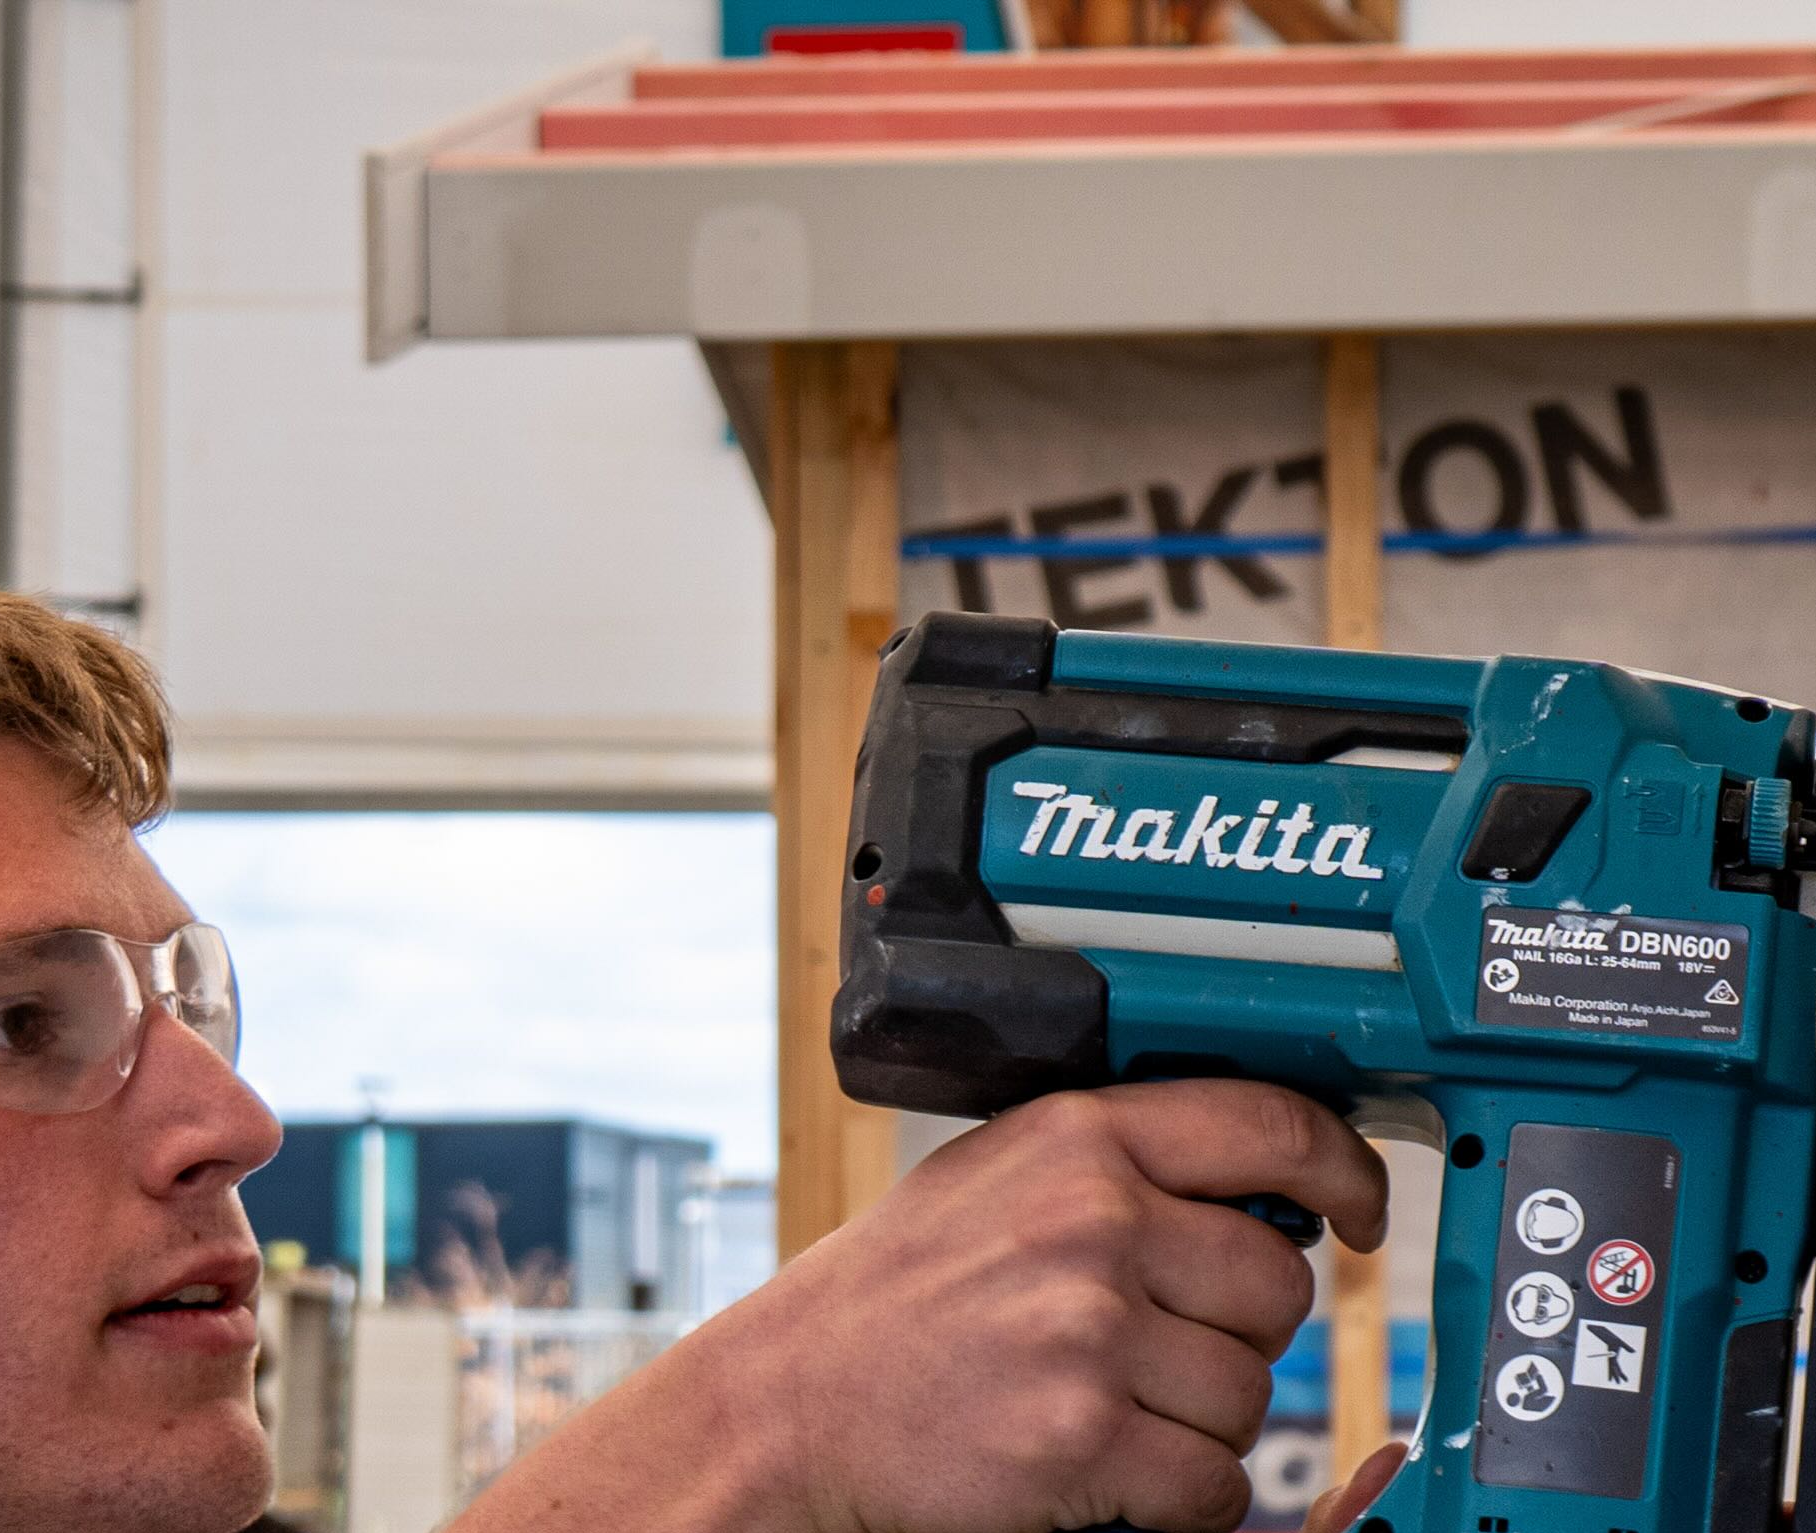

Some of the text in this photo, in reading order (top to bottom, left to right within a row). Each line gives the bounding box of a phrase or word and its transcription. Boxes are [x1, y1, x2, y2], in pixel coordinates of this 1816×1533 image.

[903, 385, 1673, 630] TEKON
[1620, 930, 1731, 961] DBN600
[1513, 949, 1545, 963] NAIL
[1549, 952, 1582, 966] 16Ga
[1601, 956, 1662, 971] 25-64mm
[1508, 991, 1551, 1007] Makita
[1554, 994, 1629, 1014] Corporation
[1568, 1011, 1649, 1029] Made in Japan
